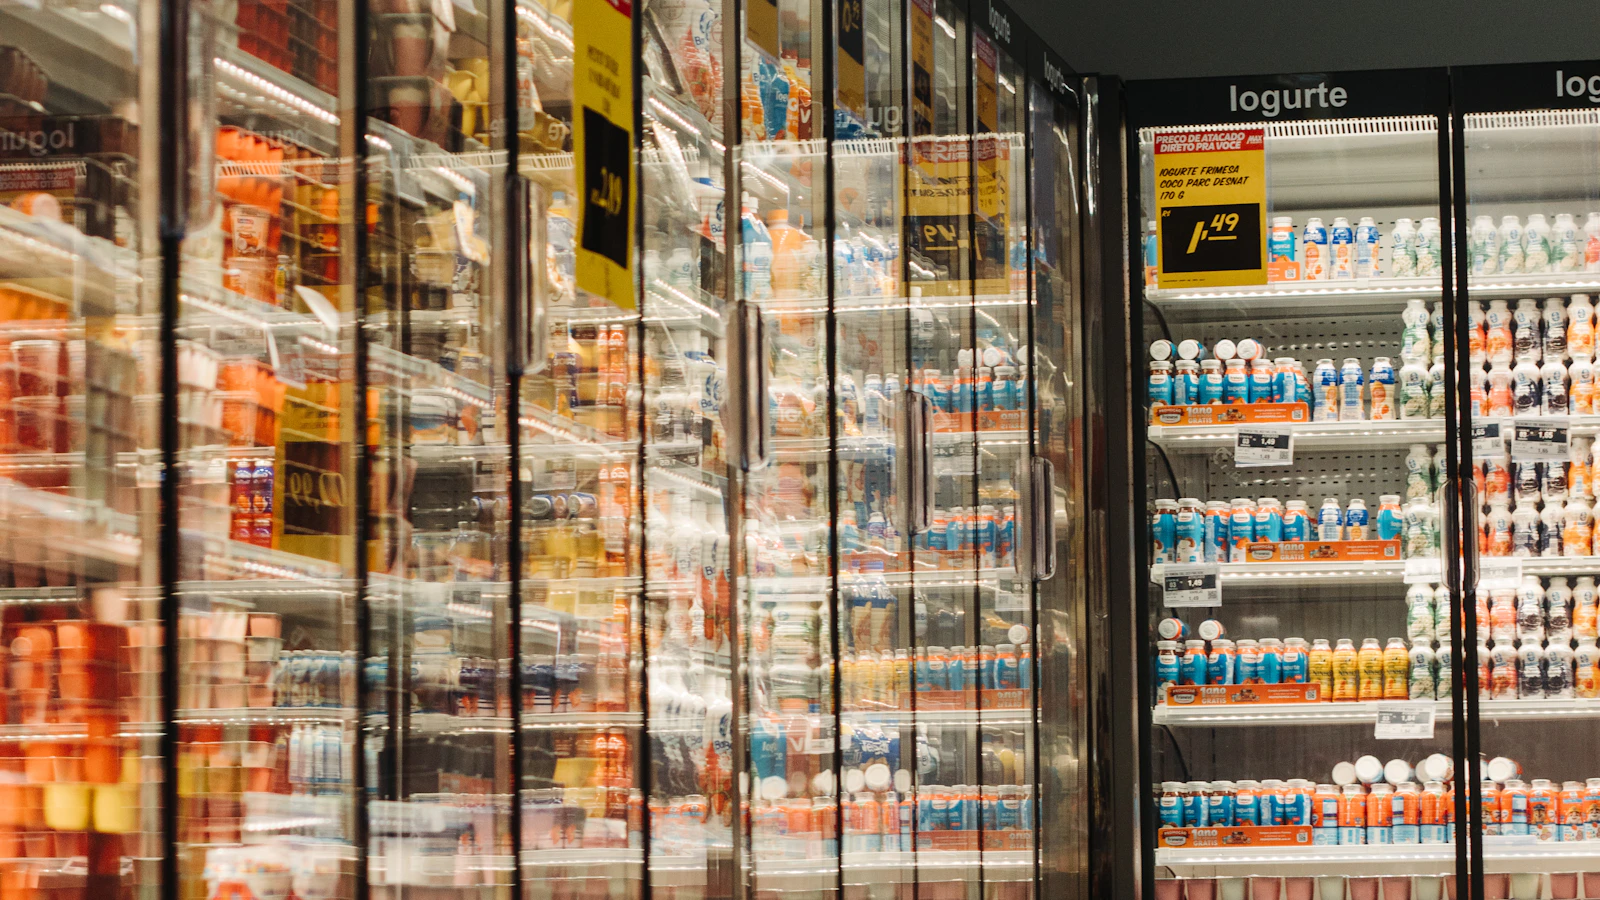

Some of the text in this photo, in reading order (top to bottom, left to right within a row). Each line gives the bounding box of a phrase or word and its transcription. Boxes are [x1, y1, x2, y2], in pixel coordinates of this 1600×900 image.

[1230, 82, 1348, 118] Iogurte
[1156, 132, 1245, 144] PREÇO DE ATACADO
[1160, 143, 1195, 152] DIRETO
[1196, 142, 1215, 151] PRA
[1159, 165, 1240, 177] IOGURTE FRIMESA
[1159, 176, 1249, 188] COCO PARC DESNAT
[1160, 190, 1185, 200] 170 G
[1186, 212, 1240, 255] 1,49
